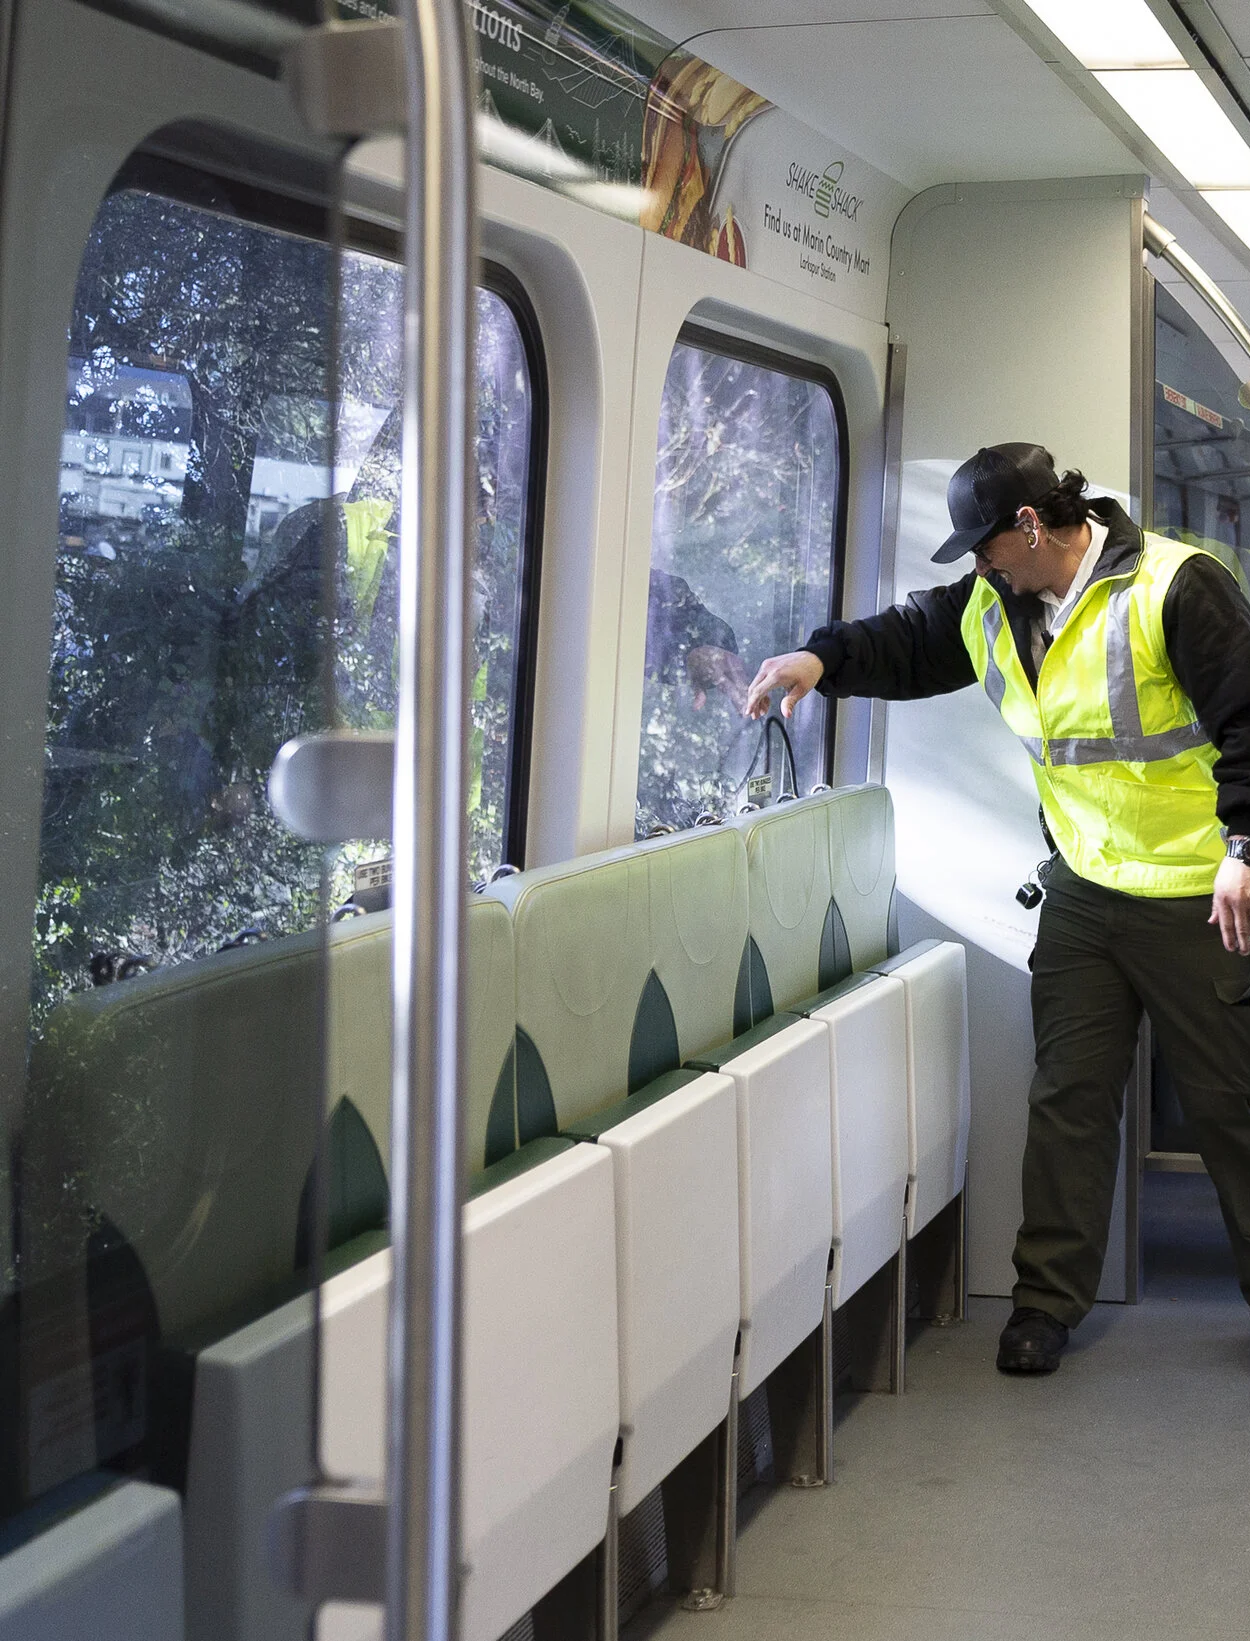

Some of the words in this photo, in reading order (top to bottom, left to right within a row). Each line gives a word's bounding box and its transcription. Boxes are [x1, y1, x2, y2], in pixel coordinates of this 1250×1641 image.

[509, 72, 529, 94] North
[786, 162, 819, 199] SHAKE
[831, 187, 864, 222] SHACK
[764, 203, 781, 233] Find
[783, 220, 791, 239] us
[792, 223, 801, 243] at
[803, 224, 824, 254] Marin
[825, 234, 853, 273] Country
[853, 248, 870, 275] Mart
[800, 252, 820, 277] Larkspur
[820, 262, 836, 282] Station
